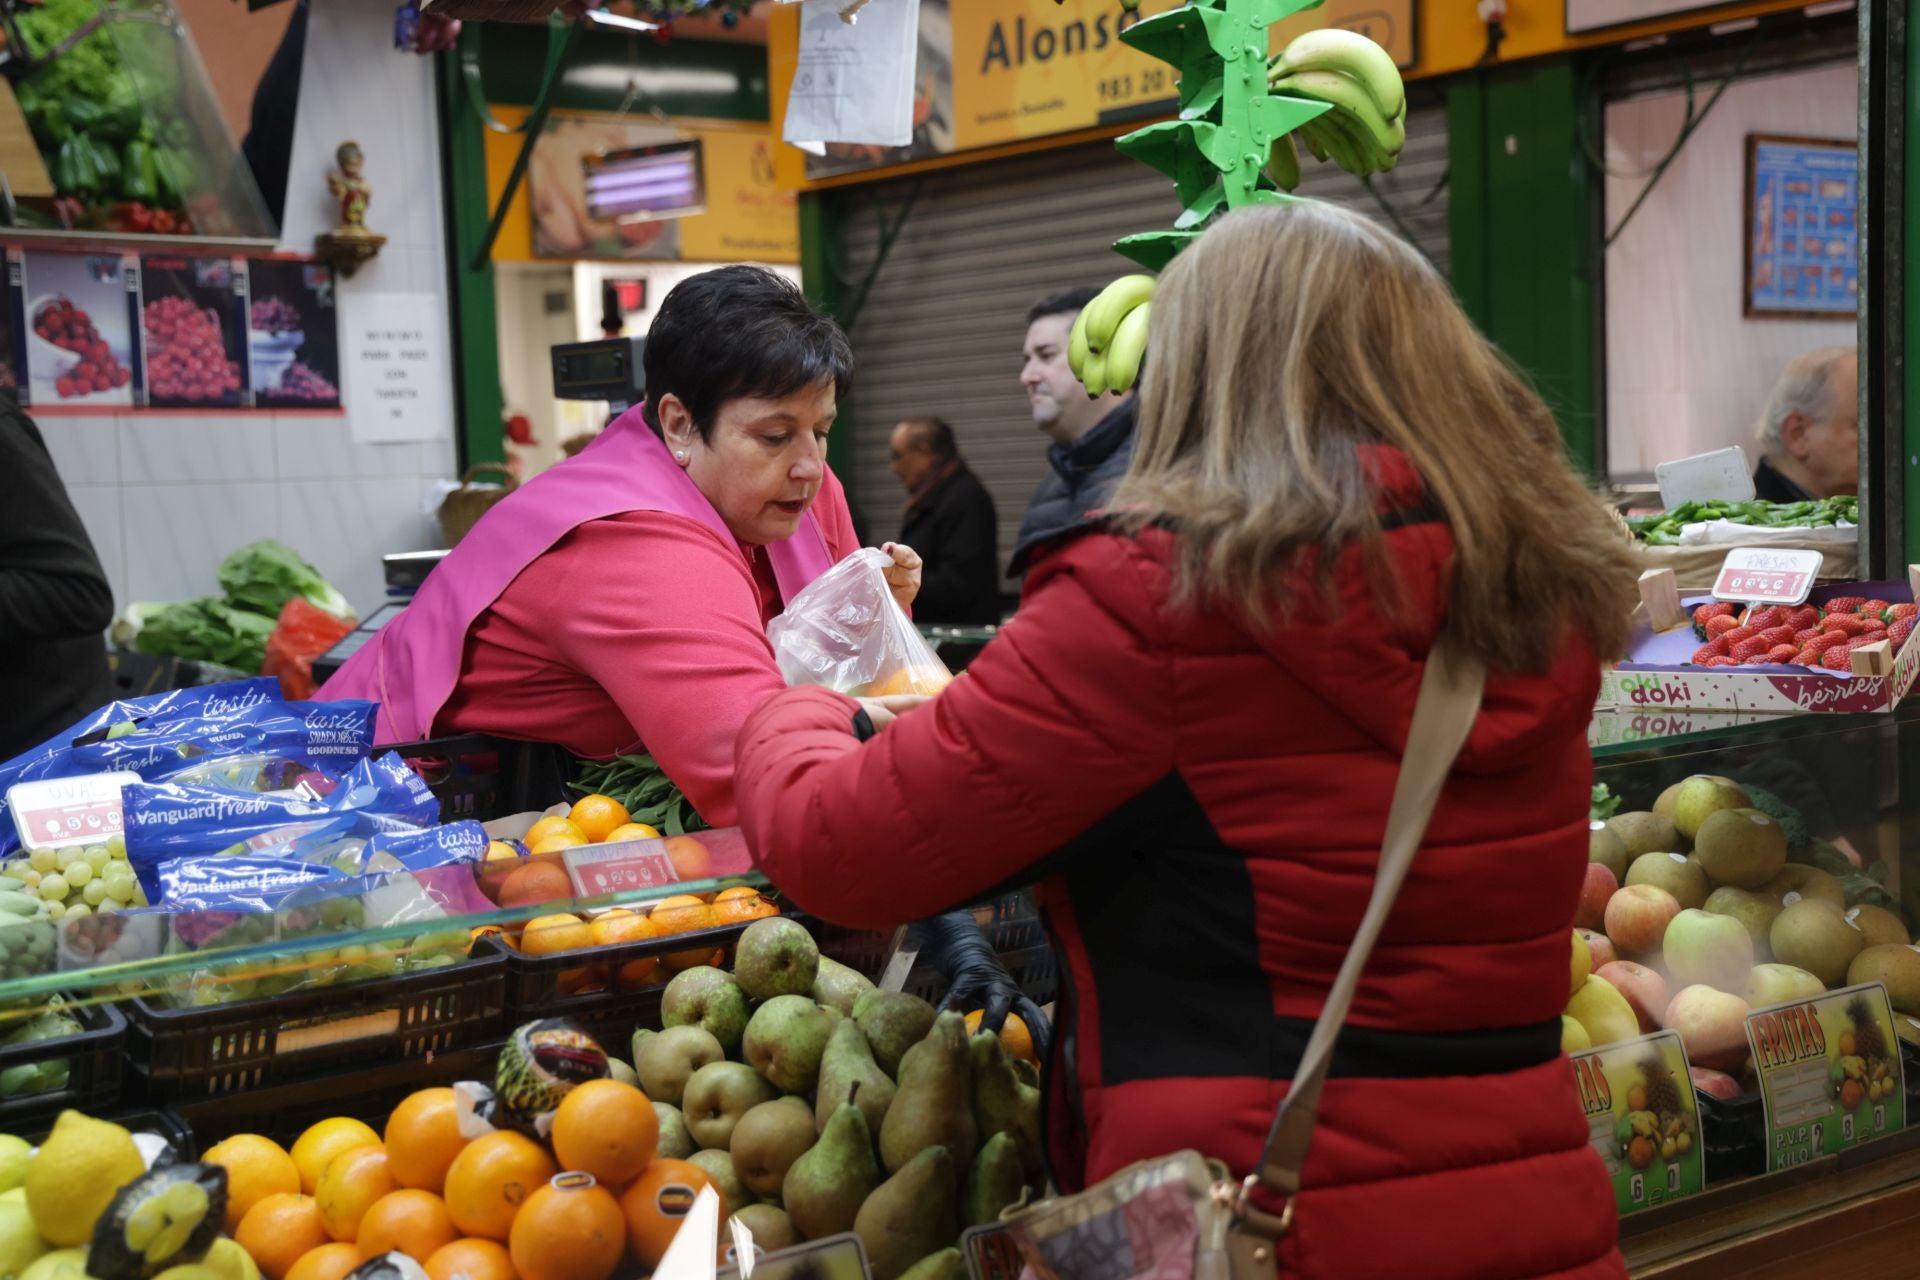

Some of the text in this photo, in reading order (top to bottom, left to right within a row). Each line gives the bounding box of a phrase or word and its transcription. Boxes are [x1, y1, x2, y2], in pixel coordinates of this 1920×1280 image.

[1631, 682, 1691, 705] doki
[1797, 676, 1884, 710] berries
[305, 708, 366, 735] tasty
[307, 746, 358, 756] GOODNESS
[438, 828, 483, 850] tasty
[1750, 1003, 1825, 1068] FRUTAS
[1777, 1127, 1808, 1149] P.V.P.
[1777, 1148, 1808, 1169] KILO
